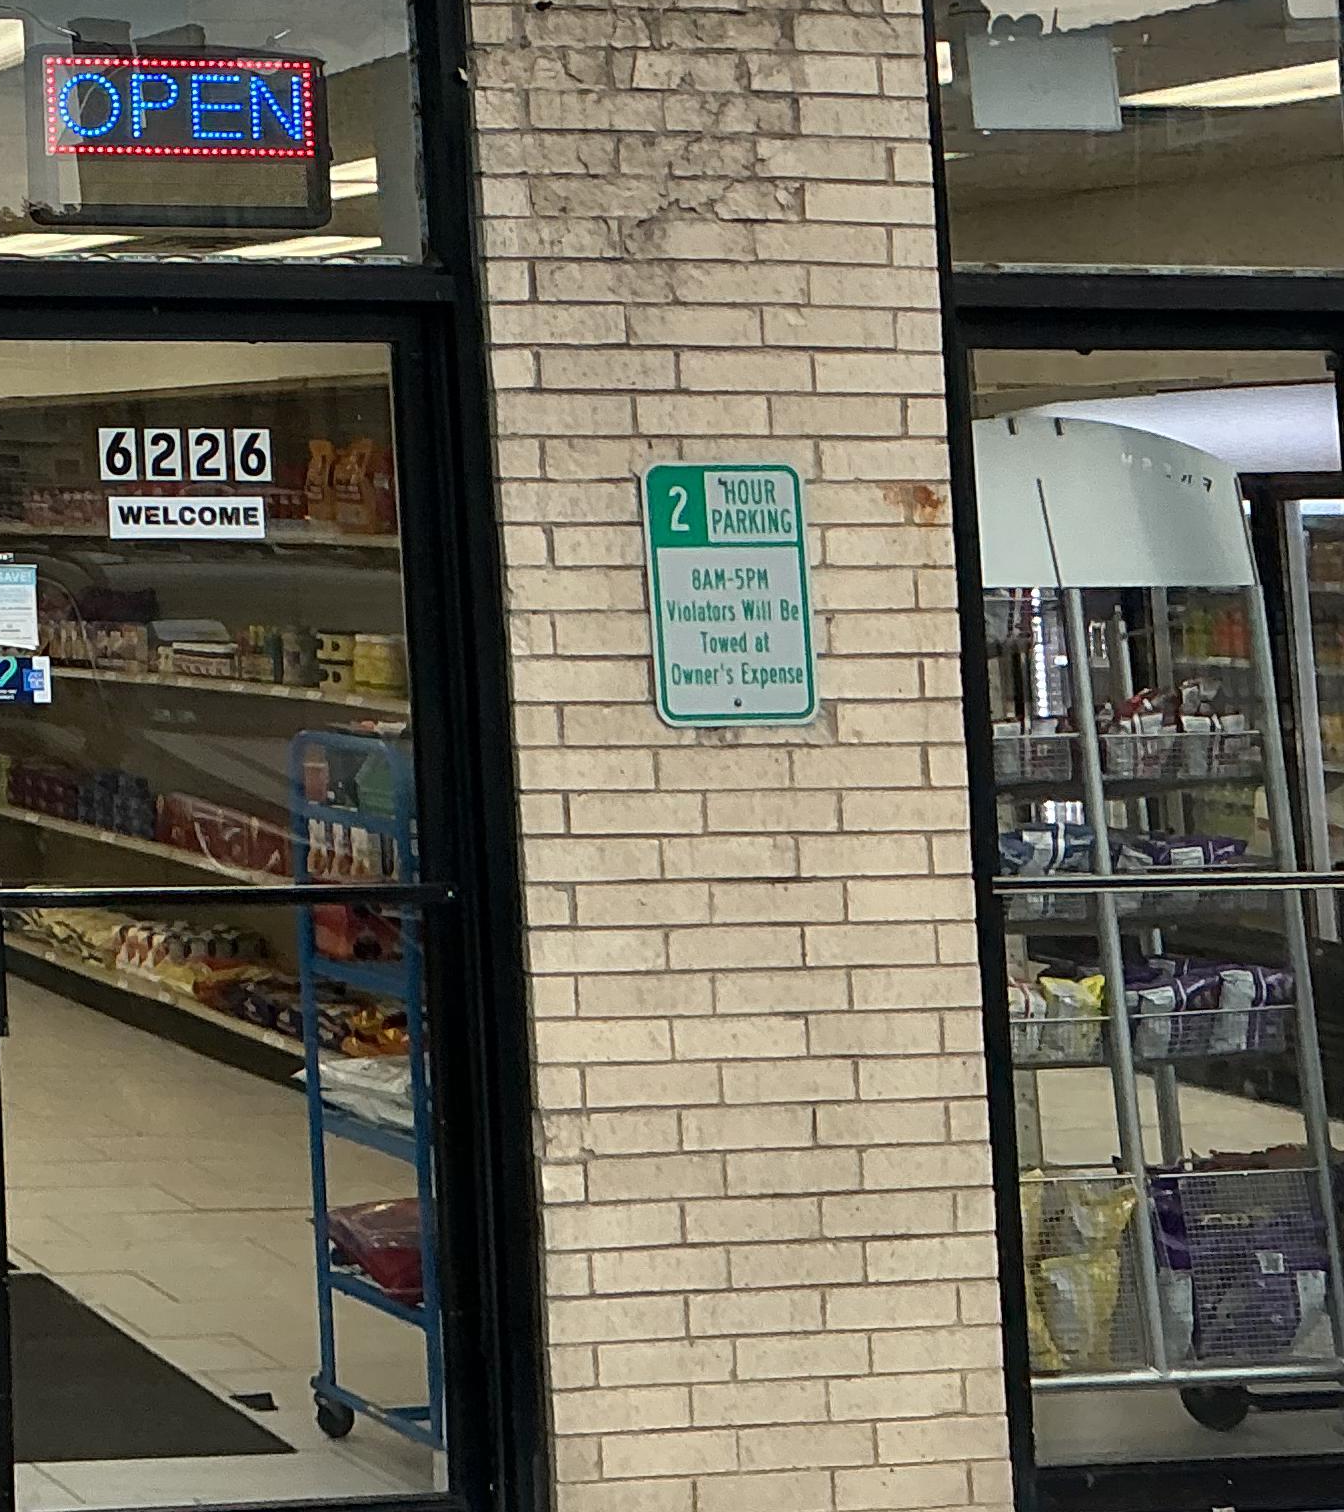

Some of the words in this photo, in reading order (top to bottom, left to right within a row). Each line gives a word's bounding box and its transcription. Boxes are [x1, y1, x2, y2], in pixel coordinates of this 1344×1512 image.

[56, 71, 306, 142] OPEN
[105, 431, 268, 478] 6226
[724, 478, 777, 505] HOUR
[117, 505, 260, 527] WELCOME
[668, 485, 690, 532] 2
[712, 508, 793, 534] PARKING
[691, 568, 770, 590] 8AM-5PM
[666, 600, 736, 623] Violators
[741, 599, 772, 622] Will
[780, 599, 799, 621] Be
[700, 631, 748, 654] Towed
[755, 631, 770, 653] at
[671, 663, 734, 686] Owner's
[741, 662, 804, 689] Expense
